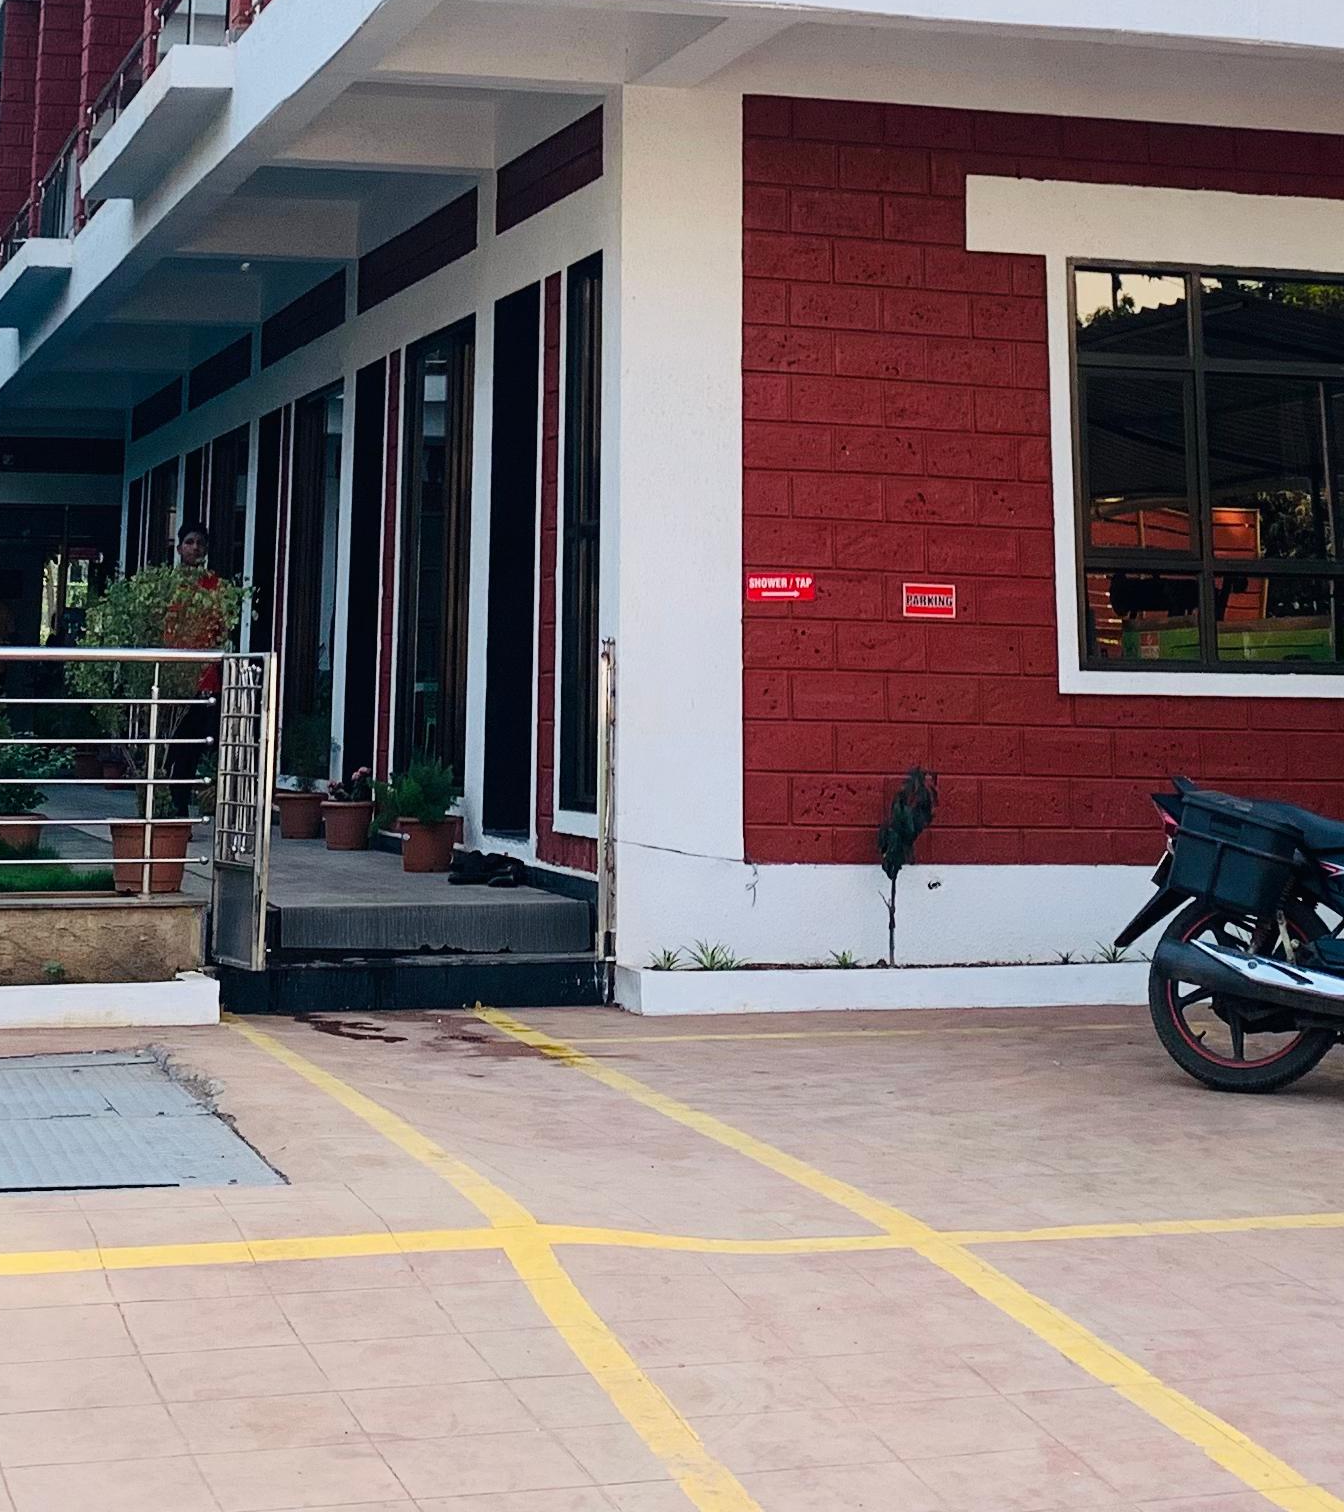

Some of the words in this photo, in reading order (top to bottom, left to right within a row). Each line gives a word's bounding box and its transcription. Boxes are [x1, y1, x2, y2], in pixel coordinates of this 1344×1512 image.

[748, 576, 788, 589] SHOWER
[794, 576, 813, 589] TAP
[905, 593, 953, 607] PARKING
